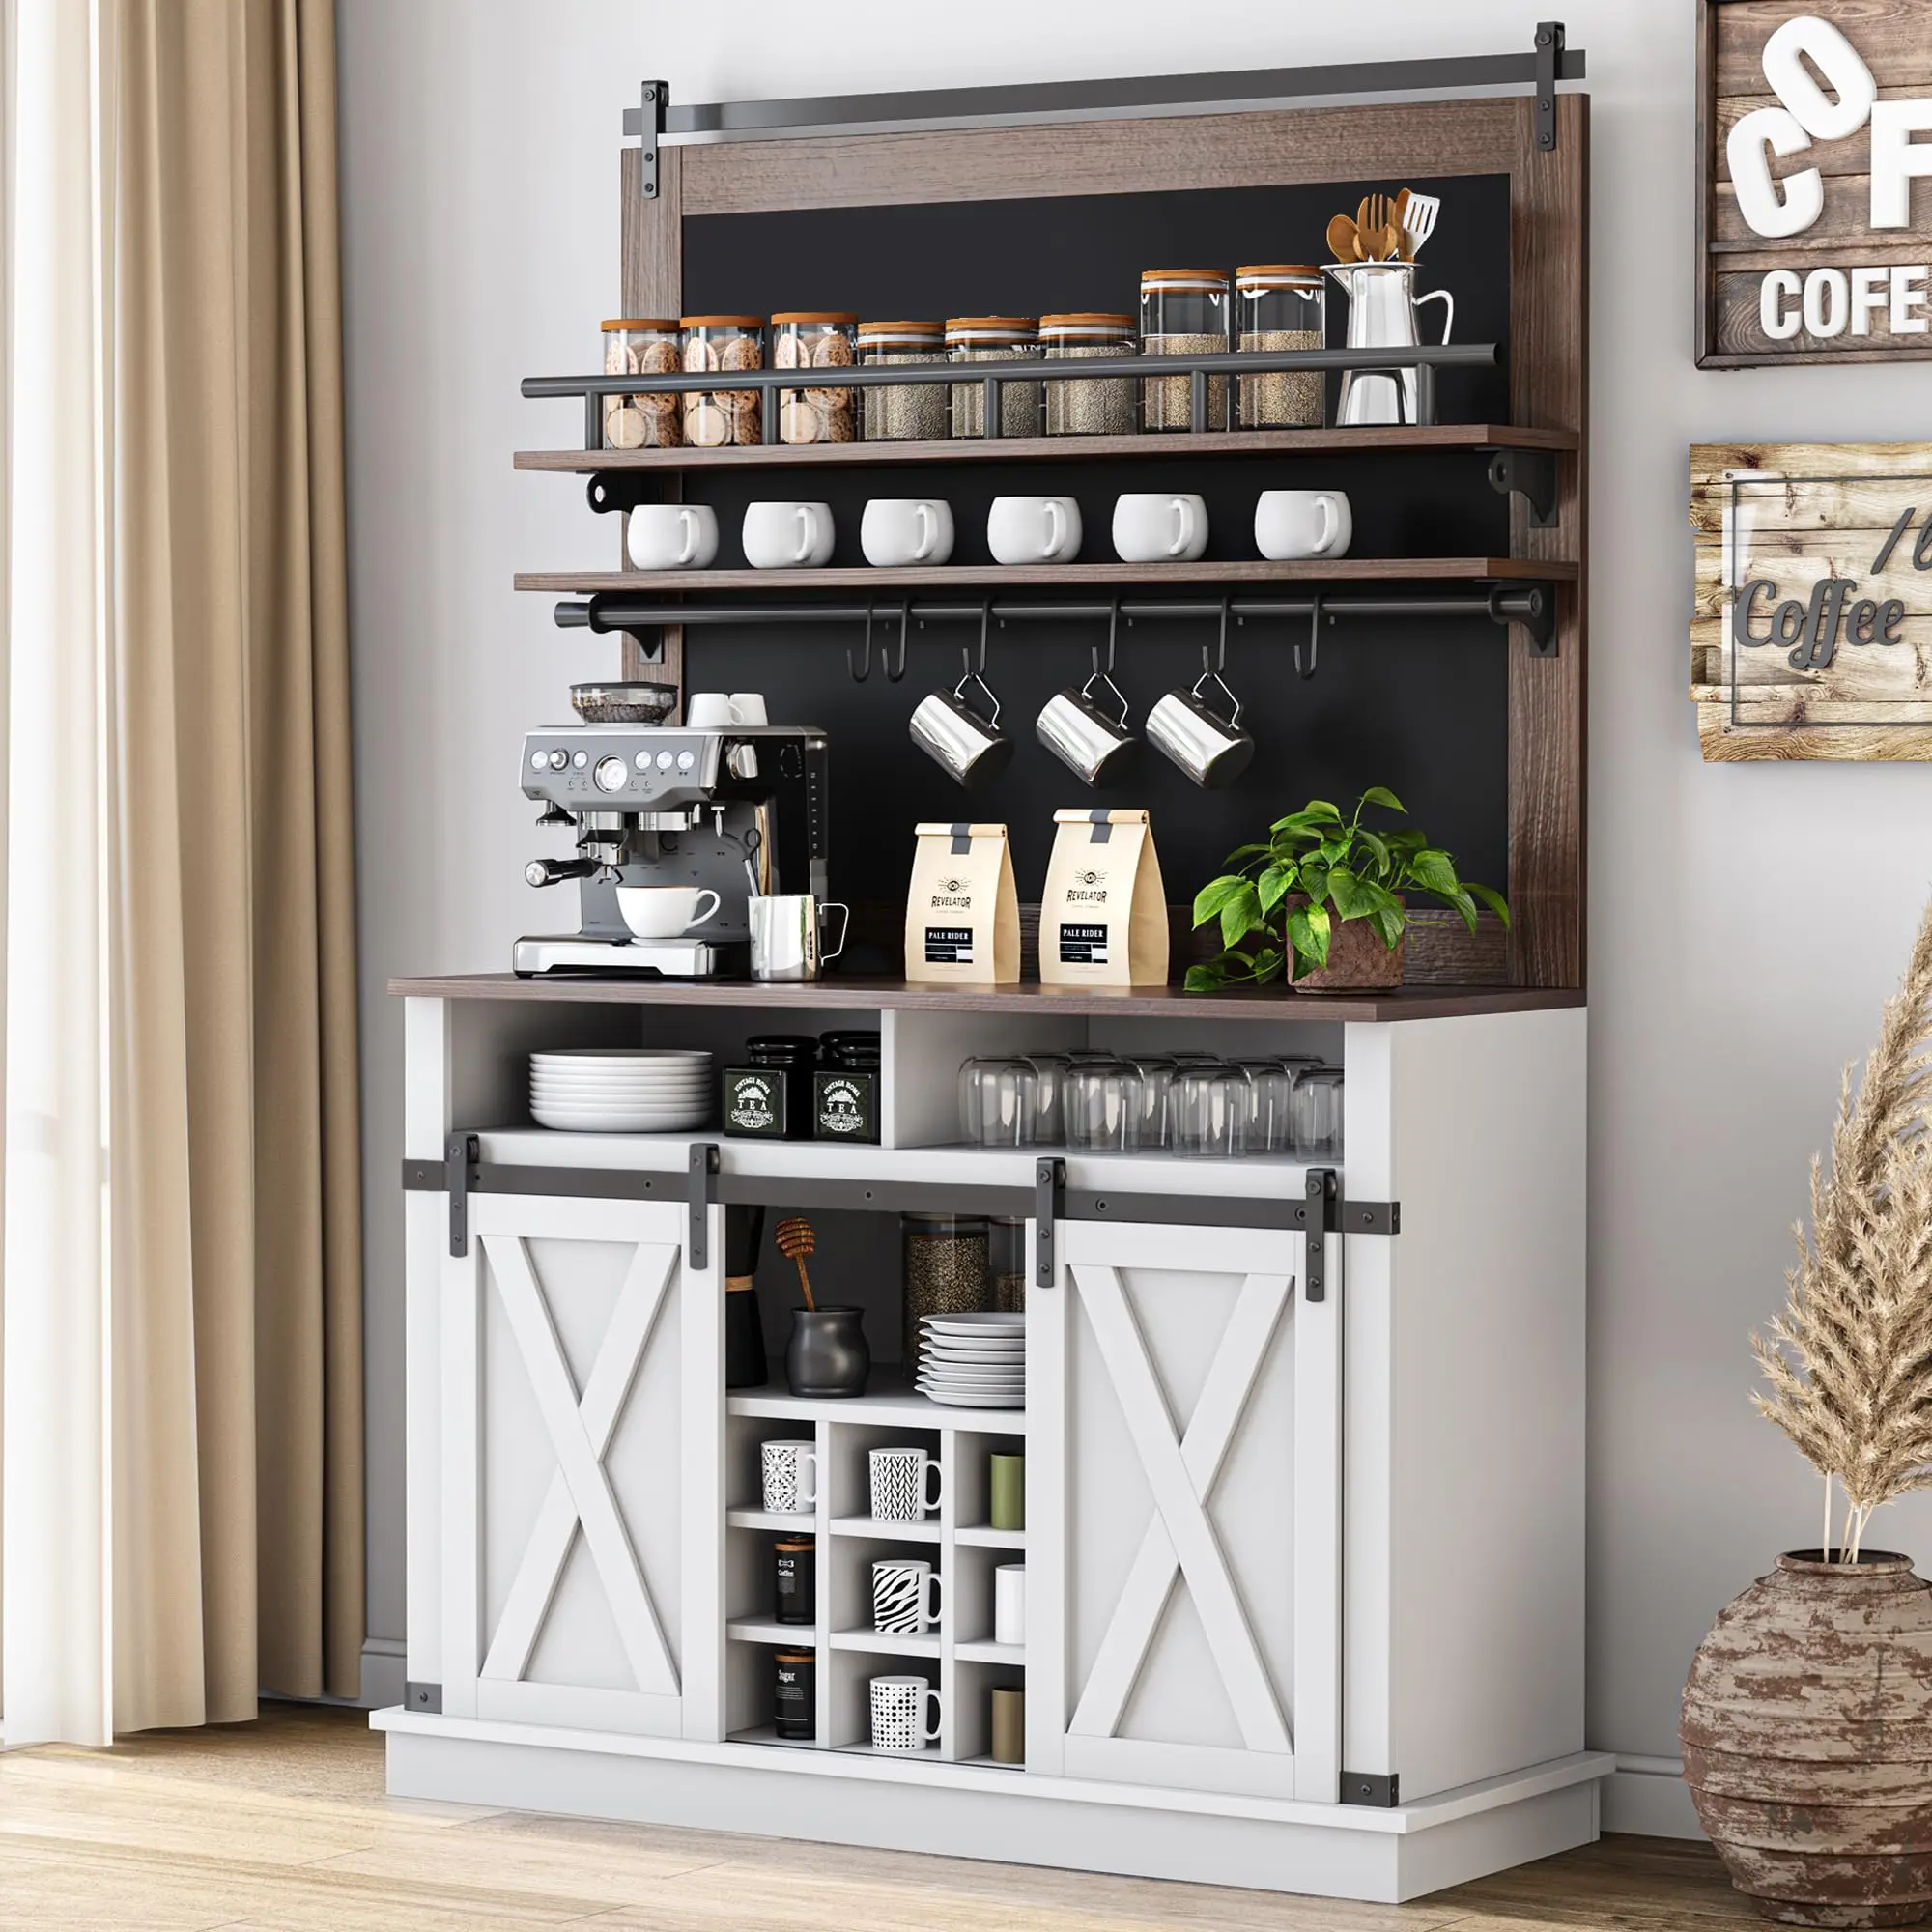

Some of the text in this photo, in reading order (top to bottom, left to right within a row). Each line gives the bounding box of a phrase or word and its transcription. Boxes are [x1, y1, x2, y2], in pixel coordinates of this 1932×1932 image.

[1734, 578, 1905, 669] Coffee
[931, 896, 971, 909] REVELATOR
[1066, 890, 1108, 903] REVELATOR
[928, 931, 969, 940] PALE RIDER
[1063, 928, 1104, 938] PALE RIDER
[734, 1076, 755, 1092] VINTAGE
